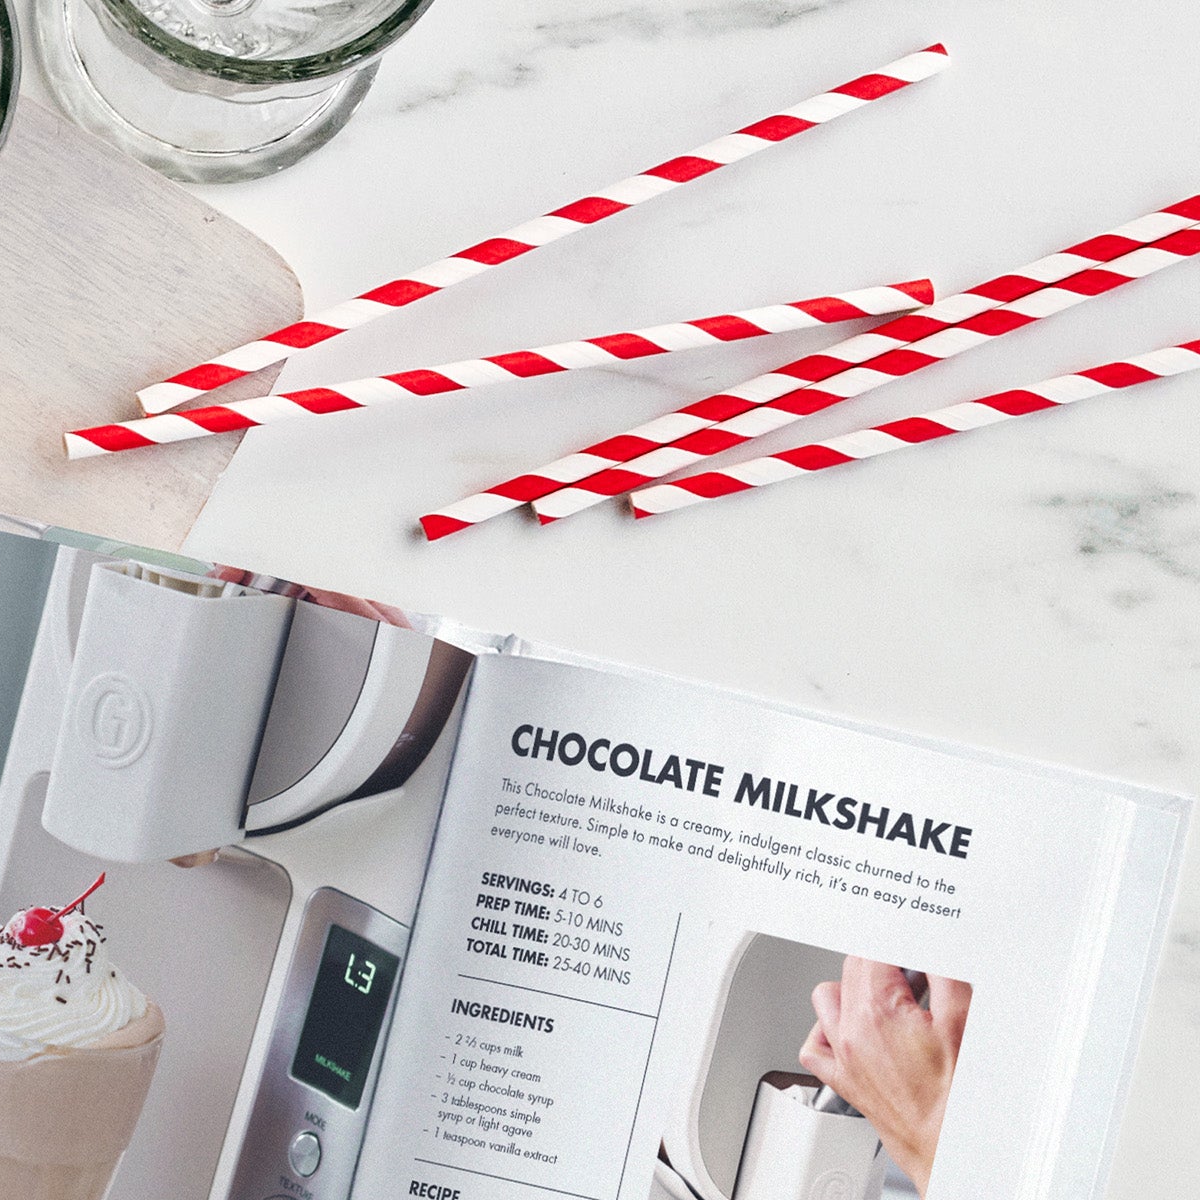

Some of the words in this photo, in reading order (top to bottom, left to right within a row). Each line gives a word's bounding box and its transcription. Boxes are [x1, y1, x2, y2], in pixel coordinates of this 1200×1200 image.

[511, 724, 724, 797] CHOCOLATE
[733, 772, 972, 859] MILKSHAKE
[490, 826, 544, 844] everyone
[549, 835, 570, 849] will
[572, 837, 601, 857] love.
[502, 778, 521, 794] This
[525, 782, 585, 806] Chocolate
[589, 795, 652, 821] Milkshake
[656, 810, 665, 824] is
[670, 817, 678, 826] a
[683, 820, 733, 842] creamy,
[739, 830, 801, 856] indulgent
[805, 846, 851, 869] classic
[855, 859, 913, 883] churned
[916, 875, 929, 888] to
[934, 878, 955, 894] the
[495, 802, 536, 819] perfect
[539, 810, 581, 829] texture.
[586, 817, 628, 839] Simple
[632, 829, 644, 842] to
[648, 835, 683, 851] make
[687, 845, 714, 858] and
[717, 848, 791, 880] delightfully
[795, 869, 822, 887] rich,
[851, 885, 868, 896] an
[873, 890, 906, 908] easy
[910, 896, 960, 918] dessert
[481, 872, 554, 897] SERVINGS:
[558, 888, 567, 899] 4
[572, 889, 589, 905] TO
[593, 895, 602, 908] 6
[476, 893, 510, 911] PREP
[514, 900, 550, 920] TIME:
[554, 909, 582, 927] 5-10
[586, 917, 622, 936] MINS
[471, 916, 506, 935] CHILL
[512, 923, 548, 943] TIME:
[552, 932, 589, 952] 20-30
[593, 942, 630, 961] MINS
[467, 938, 506, 958] TOTAL
[512, 947, 548, 966] TIME:
[553, 956, 590, 975] 25-40
[593, 966, 630, 984] MINS
[451, 998, 554, 1033] INGREDIENTS
[455, 1033, 462, 1045] 2
[479, 1042, 501, 1054] cups
[503, 1045, 523, 1057] milk
[314, 1053, 351, 1082] MILKSHAKE
[452, 1053, 456, 1063] 1
[459, 1059, 477, 1071] cup
[479, 1058, 508, 1078] heavy
[511, 1069, 540, 1082] cream
[441, 1092, 448, 1103] 3
[451, 1095, 506, 1116] tablespoons
[510, 1108, 540, 1124] simple
[458, 1079, 475, 1091] cup
[478, 1079, 524, 1099] chocolate
[527, 1093, 553, 1108] syrup
[437, 1110, 463, 1124] syrup
[465, 1116, 475, 1124] or
[478, 1115, 499, 1131] light
[502, 1125, 532, 1137] agave
[435, 1126, 439, 1137] 1
[443, 1131, 485, 1148] teaspoon
[489, 1142, 521, 1155] vanilla
[523, 1150, 557, 1164] extract
